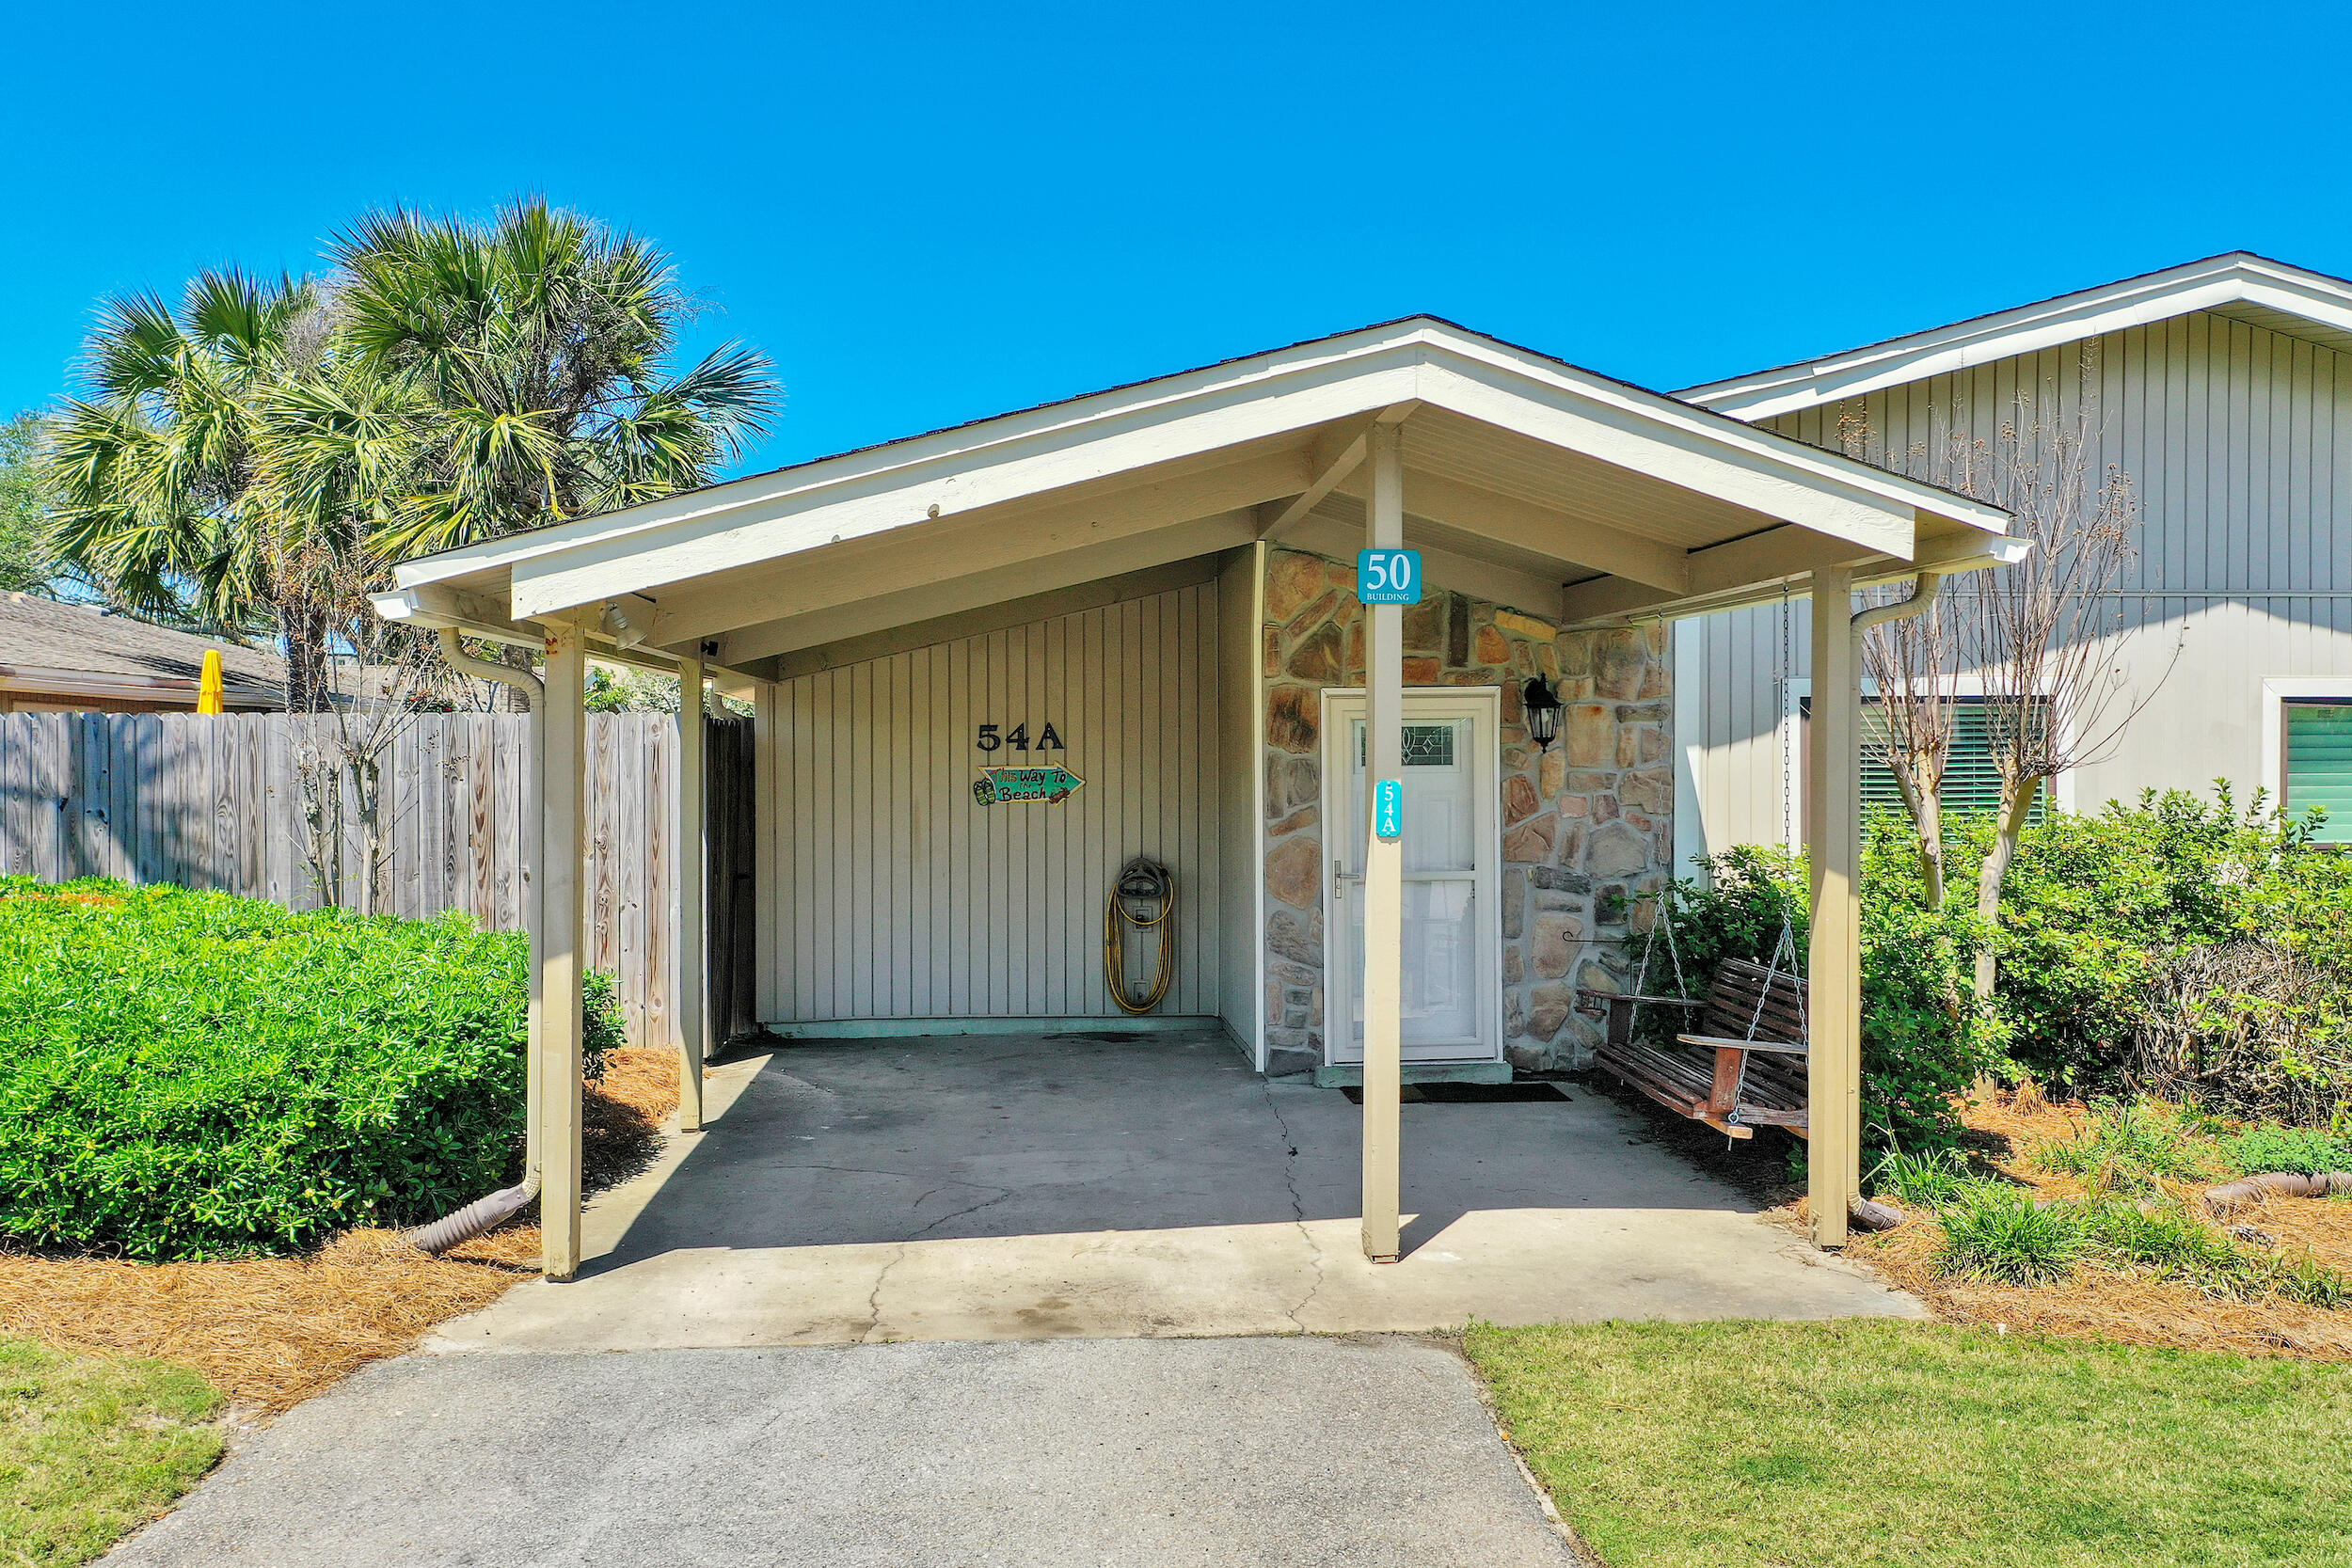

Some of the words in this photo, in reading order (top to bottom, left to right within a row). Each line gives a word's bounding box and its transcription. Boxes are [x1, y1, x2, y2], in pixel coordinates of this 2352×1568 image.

[1366, 554, 1411, 591] 50
[1366, 593, 1409, 601] BUILDING
[977, 721, 1065, 752] 54A
[989, 768, 1018, 783] This
[1020, 769, 1046, 785] Way
[1051, 770, 1067, 784] To
[999, 787, 1047, 801] Beach
[1381, 785, 1397, 832] 54A
